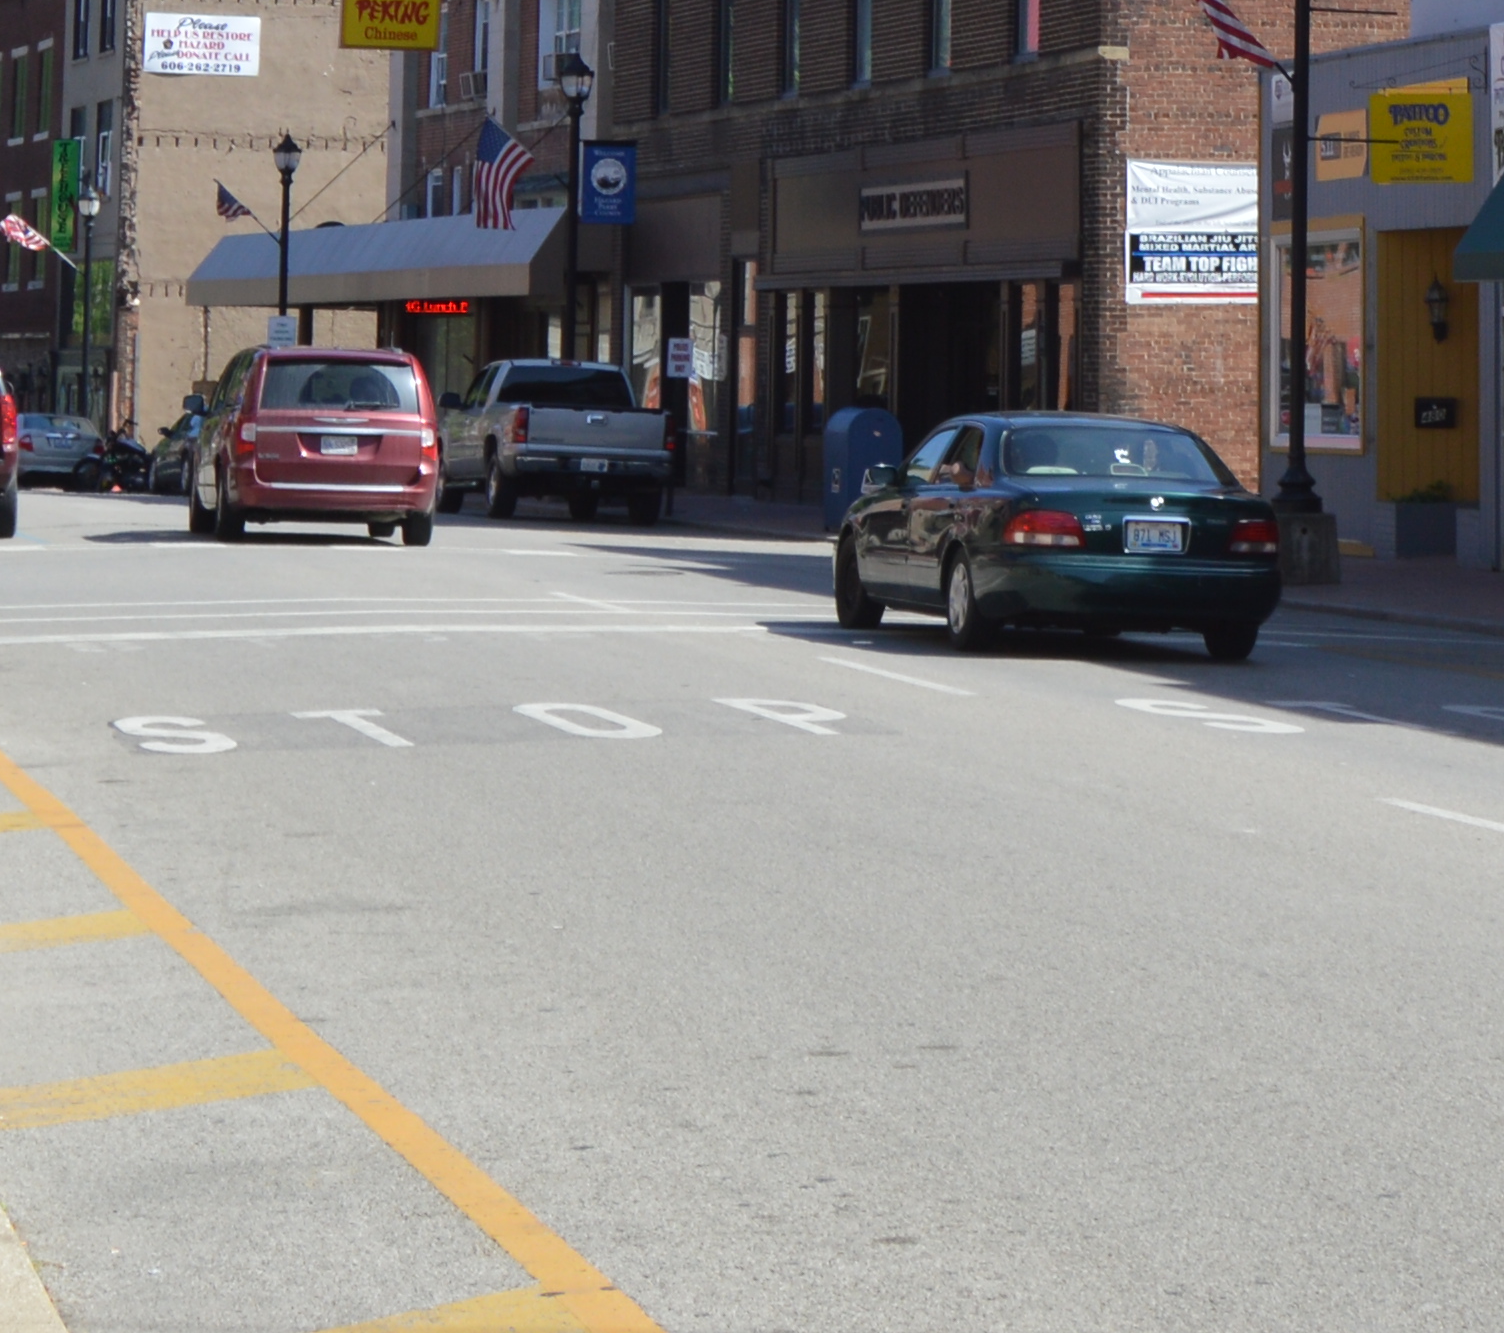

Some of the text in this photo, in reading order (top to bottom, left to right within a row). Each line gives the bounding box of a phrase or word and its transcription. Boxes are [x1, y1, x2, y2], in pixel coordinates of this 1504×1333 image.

[151, 29, 253, 41] HELP US RESTORE
[364, 26, 418, 41] Chinese
[179, 40, 225, 50] HAZARD
[224, 52, 251, 61] CALL
[1388, 103, 1450, 126] TATTOO
[1131, 185, 1160, 194] Mental
[1193, 186, 1232, 195] Substance
[1141, 197, 1158, 205] DUI
[1160, 197, 1200, 207] Programs
[1139, 234, 1207, 243] BRAZILIAN
[1210, 235, 1232, 243] JIU
[1139, 243, 1180, 251] MIXED
[1182, 243, 1236, 251] MARTIAL
[1143, 256, 1258, 272] TEAM TOP FIGH
[111, 696, 848, 755] STOP
